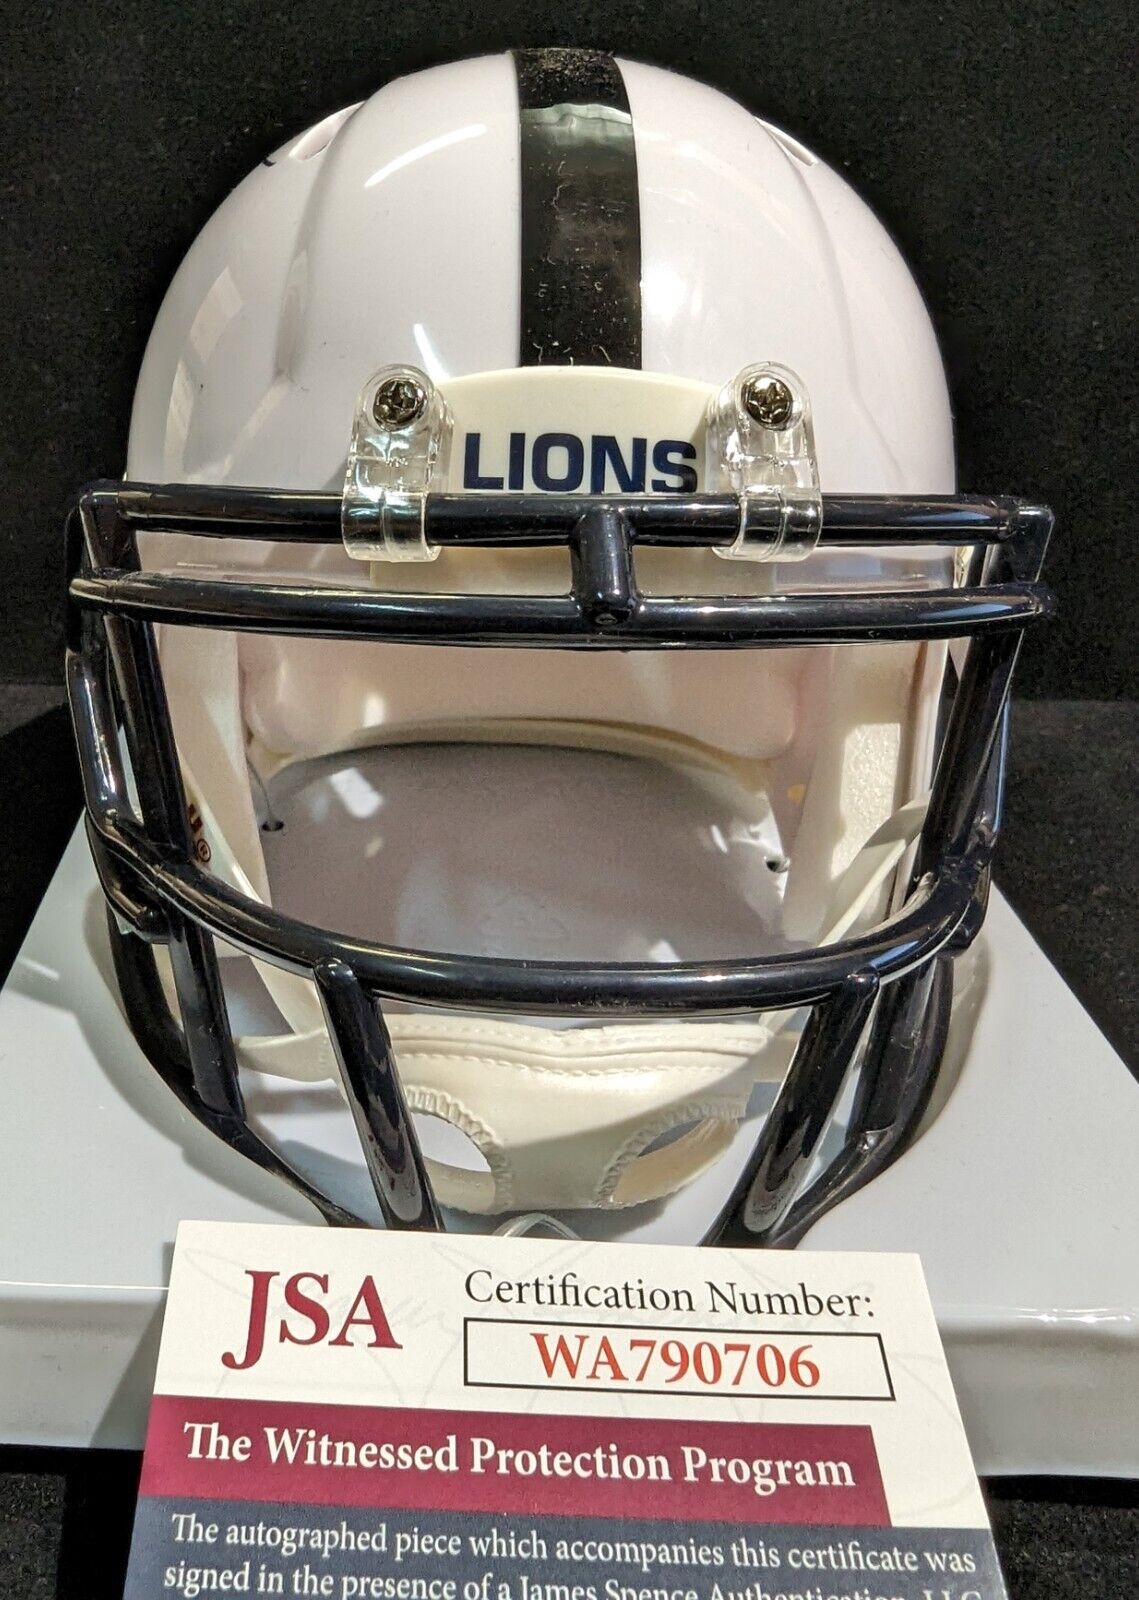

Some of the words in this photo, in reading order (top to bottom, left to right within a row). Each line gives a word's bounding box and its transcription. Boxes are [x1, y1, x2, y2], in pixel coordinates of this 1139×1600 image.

[463, 432, 698, 494] LIONS
[221, 1269, 403, 1370] JSA
[464, 1269, 696, 1312] Certification
[706, 1281, 875, 1318] Number:
[530, 1332, 820, 1388] WA790706
[184, 1422, 251, 1461] The
[263, 1427, 459, 1472] Witnessed
[470, 1437, 673, 1481] Protection
[681, 1446, 856, 1496] Program
[172, 1513, 219, 1544] The
[226, 1521, 388, 1557] autographed
[395, 1527, 462, 1561] piece
[469, 1528, 548, 1560] which
[556, 1539, 723, 1572] accompanies
[731, 1537, 781, 1569] this
[788, 1541, 918, 1572] certificate
[925, 1552, 976, 1574] was
[164, 1560, 250, 1598] signed
[257, 1564, 284, 1594] in
[292, 1564, 334, 1596] the
[341, 1571, 457, 1600] presence
[464, 1573, 493, 1600] of
[498, 1583, 511, 1600] a
[519, 1576, 598, 1600] James
